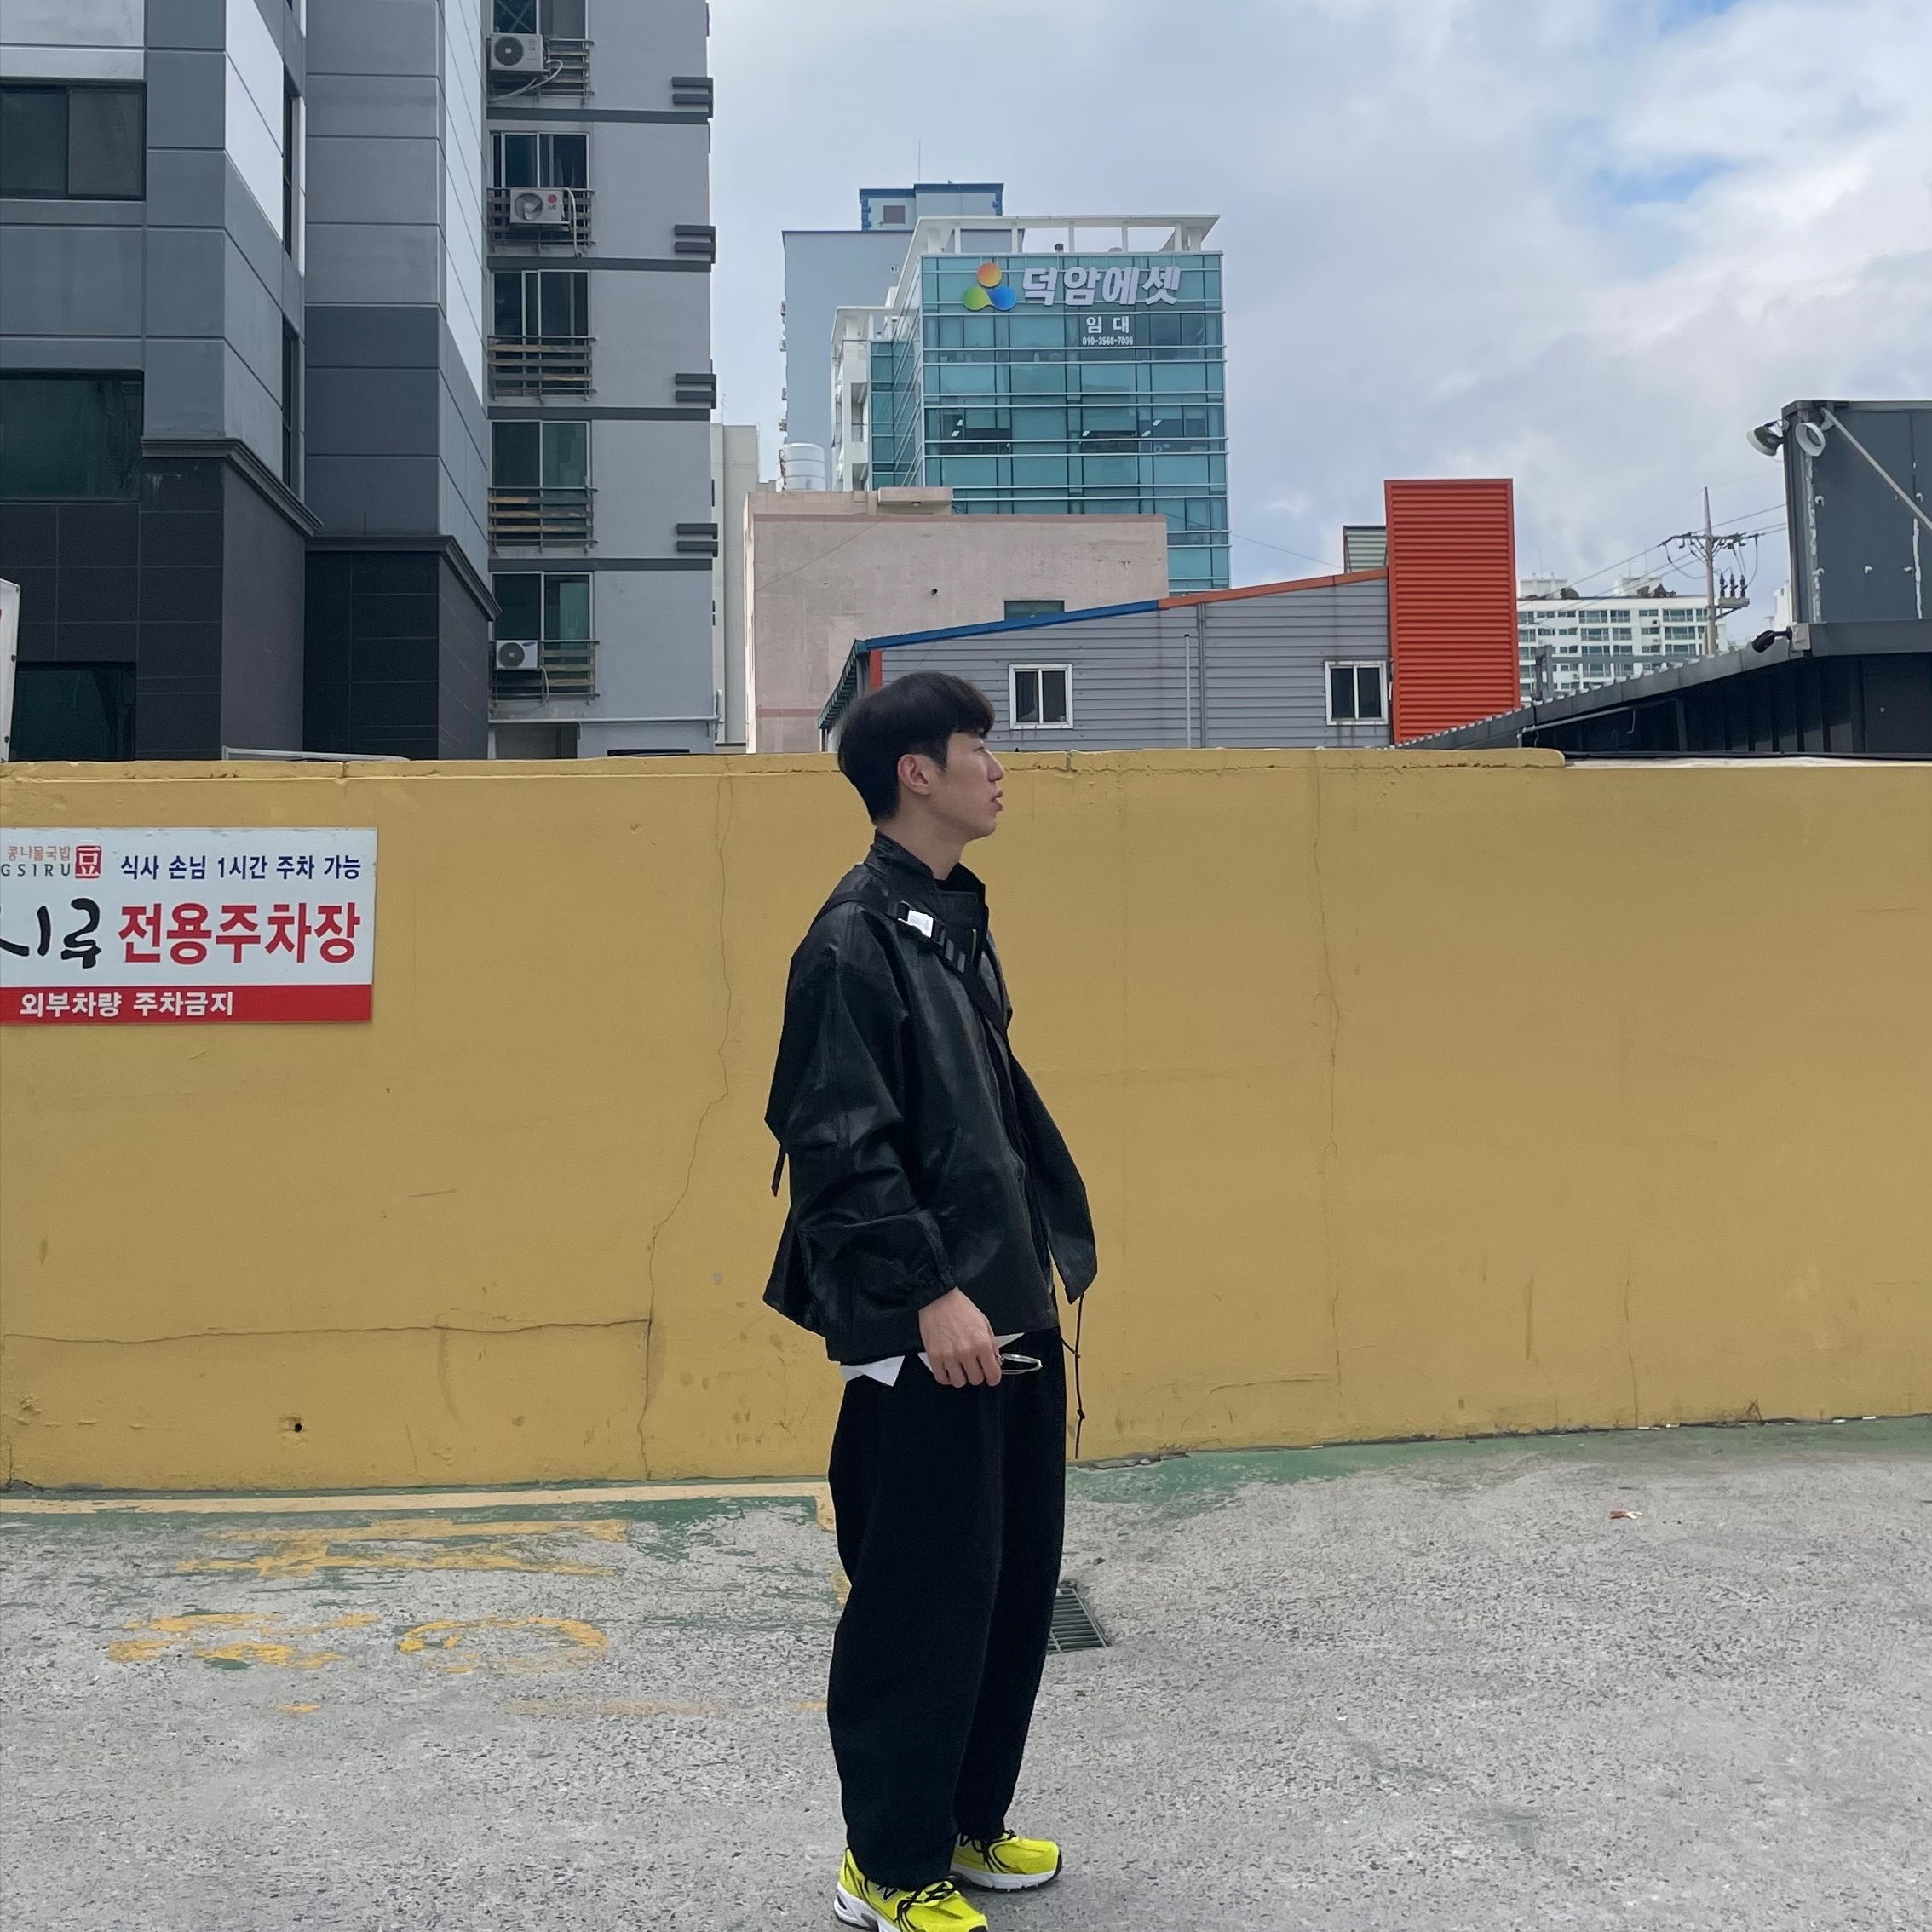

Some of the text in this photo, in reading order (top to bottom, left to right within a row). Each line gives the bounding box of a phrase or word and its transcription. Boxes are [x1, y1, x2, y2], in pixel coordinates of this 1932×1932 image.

[1022, 267, 1182, 307] 덕암에셋
[7, 845, 71, 862] 콩나물국밥
[0, 863, 71, 877] GSIRU
[120, 854, 361, 880] 식사 손님 1시간 주차 가능
[118, 901, 361, 965] 전용주차장
[20, 991, 234, 1017] 외부차량 주차금지
